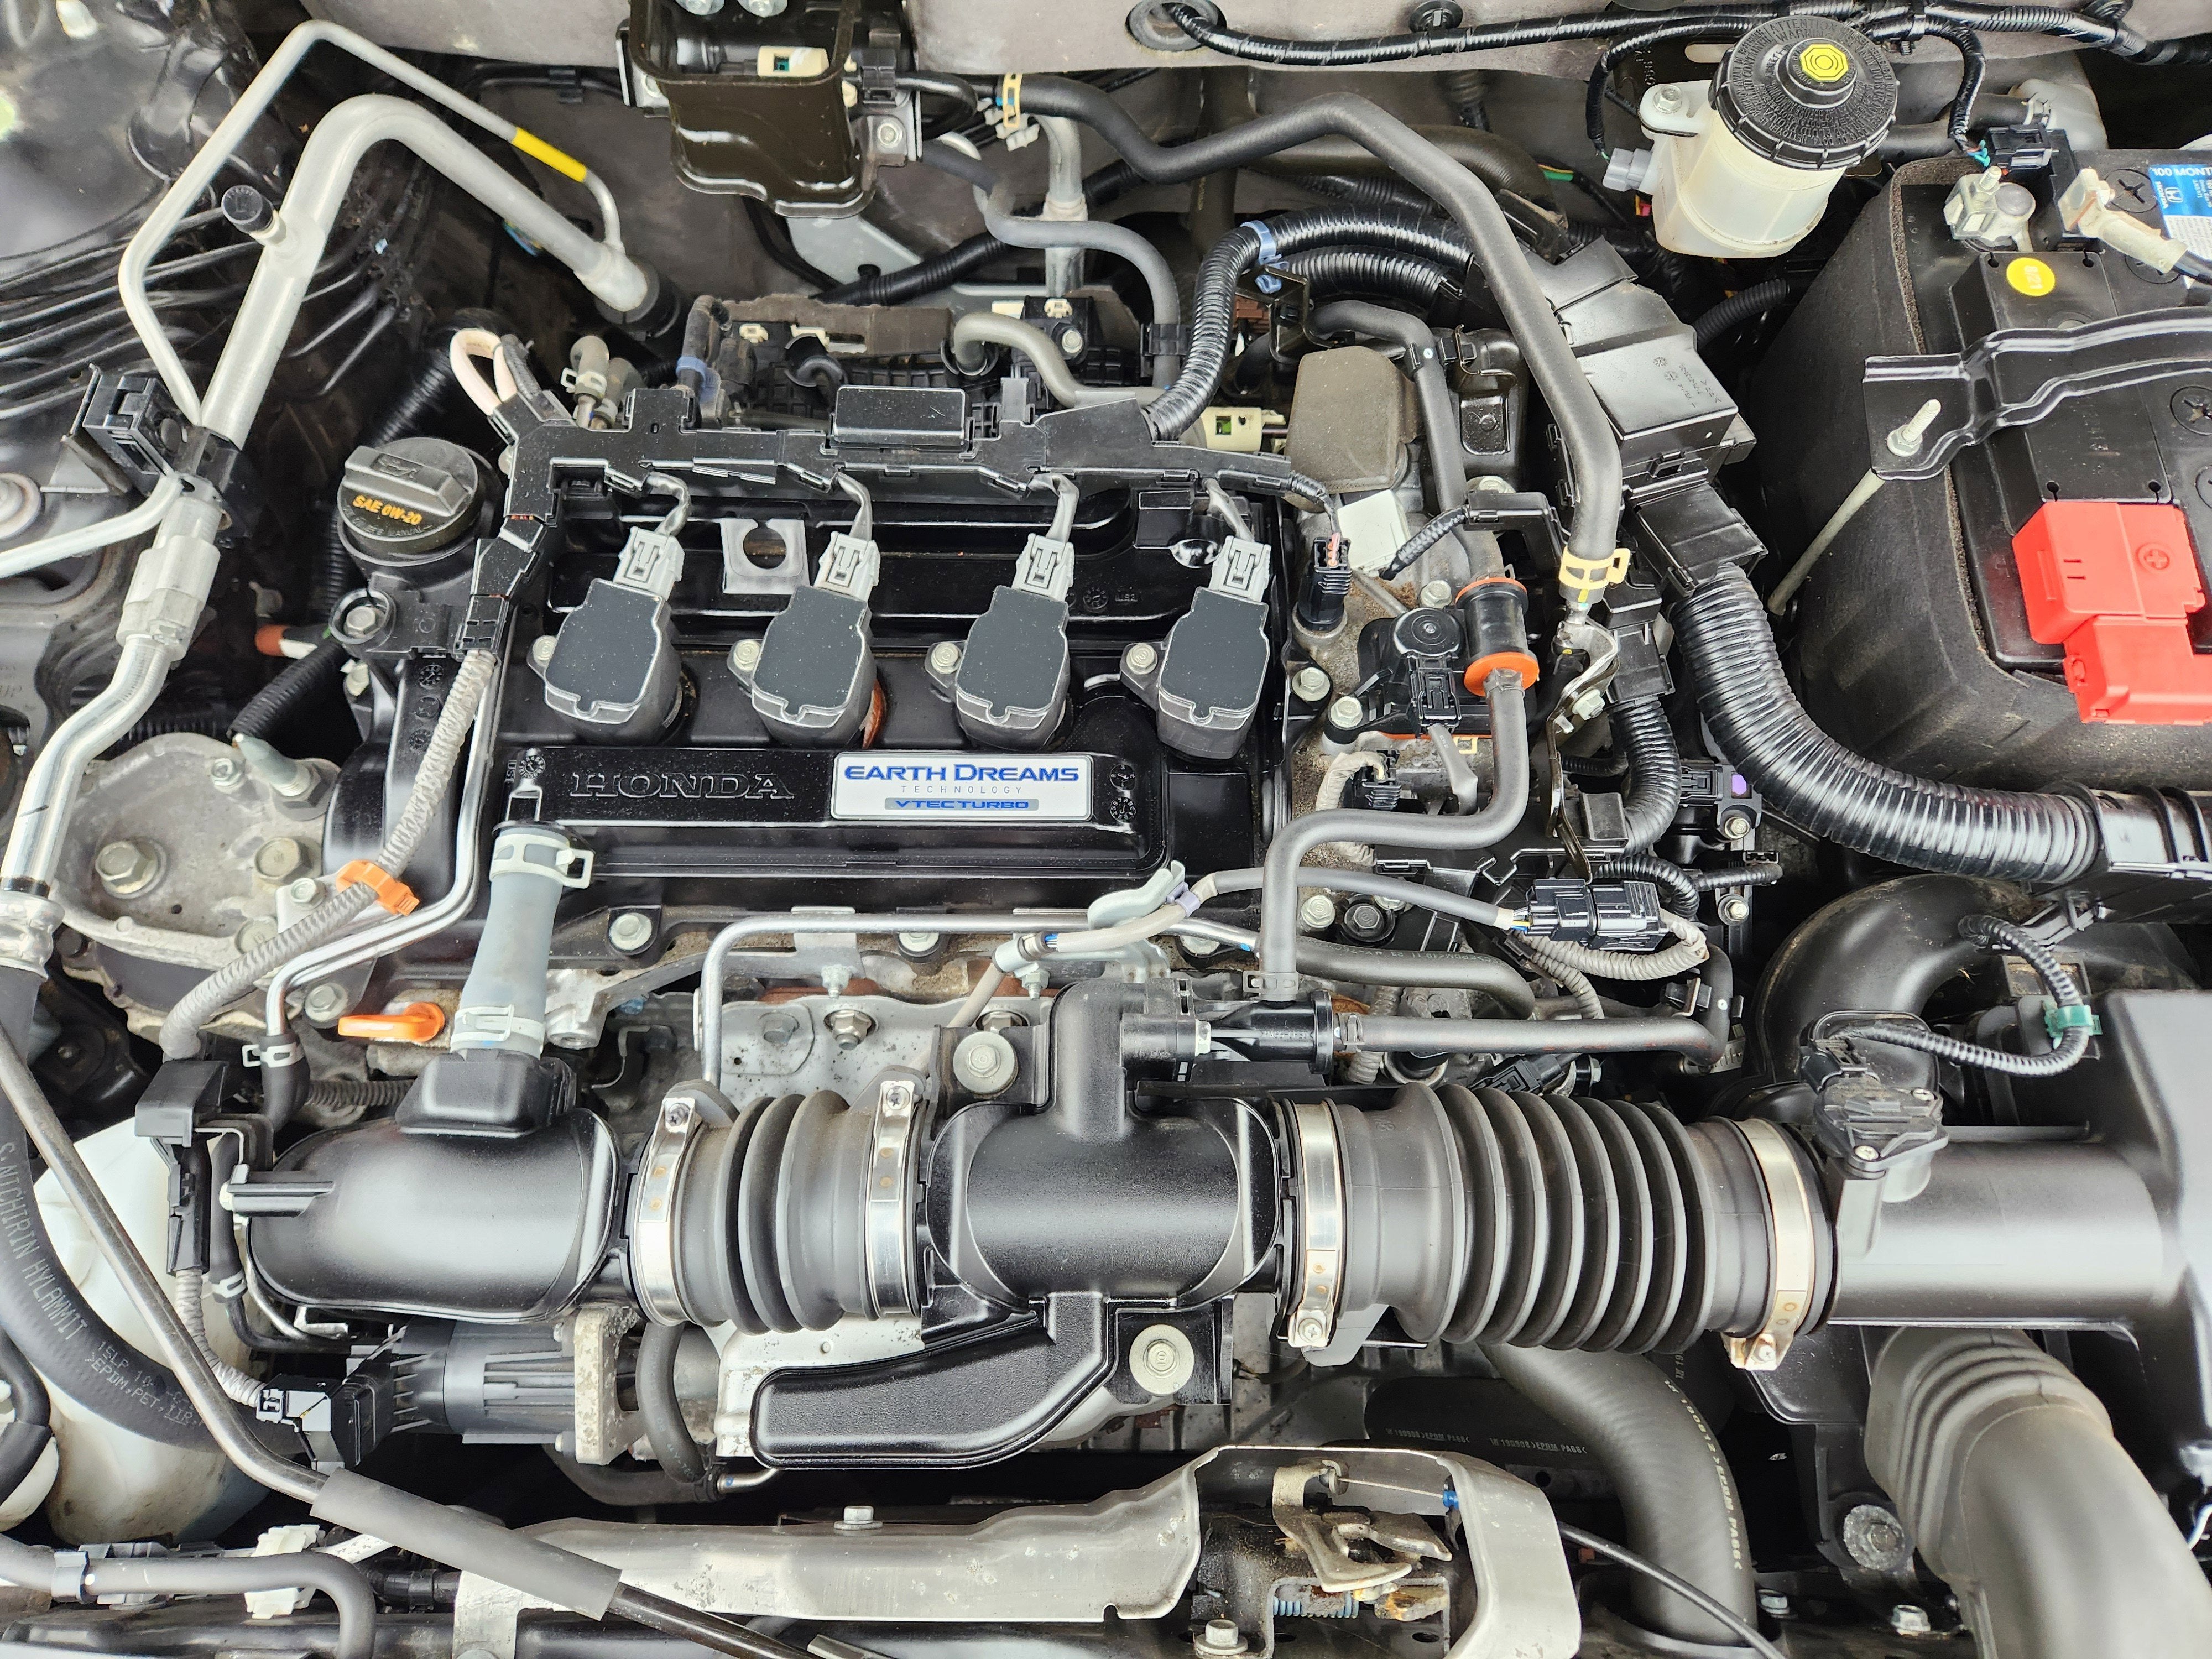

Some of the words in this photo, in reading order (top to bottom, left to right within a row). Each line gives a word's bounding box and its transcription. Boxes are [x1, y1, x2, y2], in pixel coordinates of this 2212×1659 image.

[2154, 181, 2168, 209] HONDA
[352, 495, 384, 513] SAE
[380, 504, 422, 525] 0W-20
[569, 771, 795, 800] HONDA
[844, 765, 946, 781] EARTH
[901, 785, 1023, 795] TECHNOLOGY
